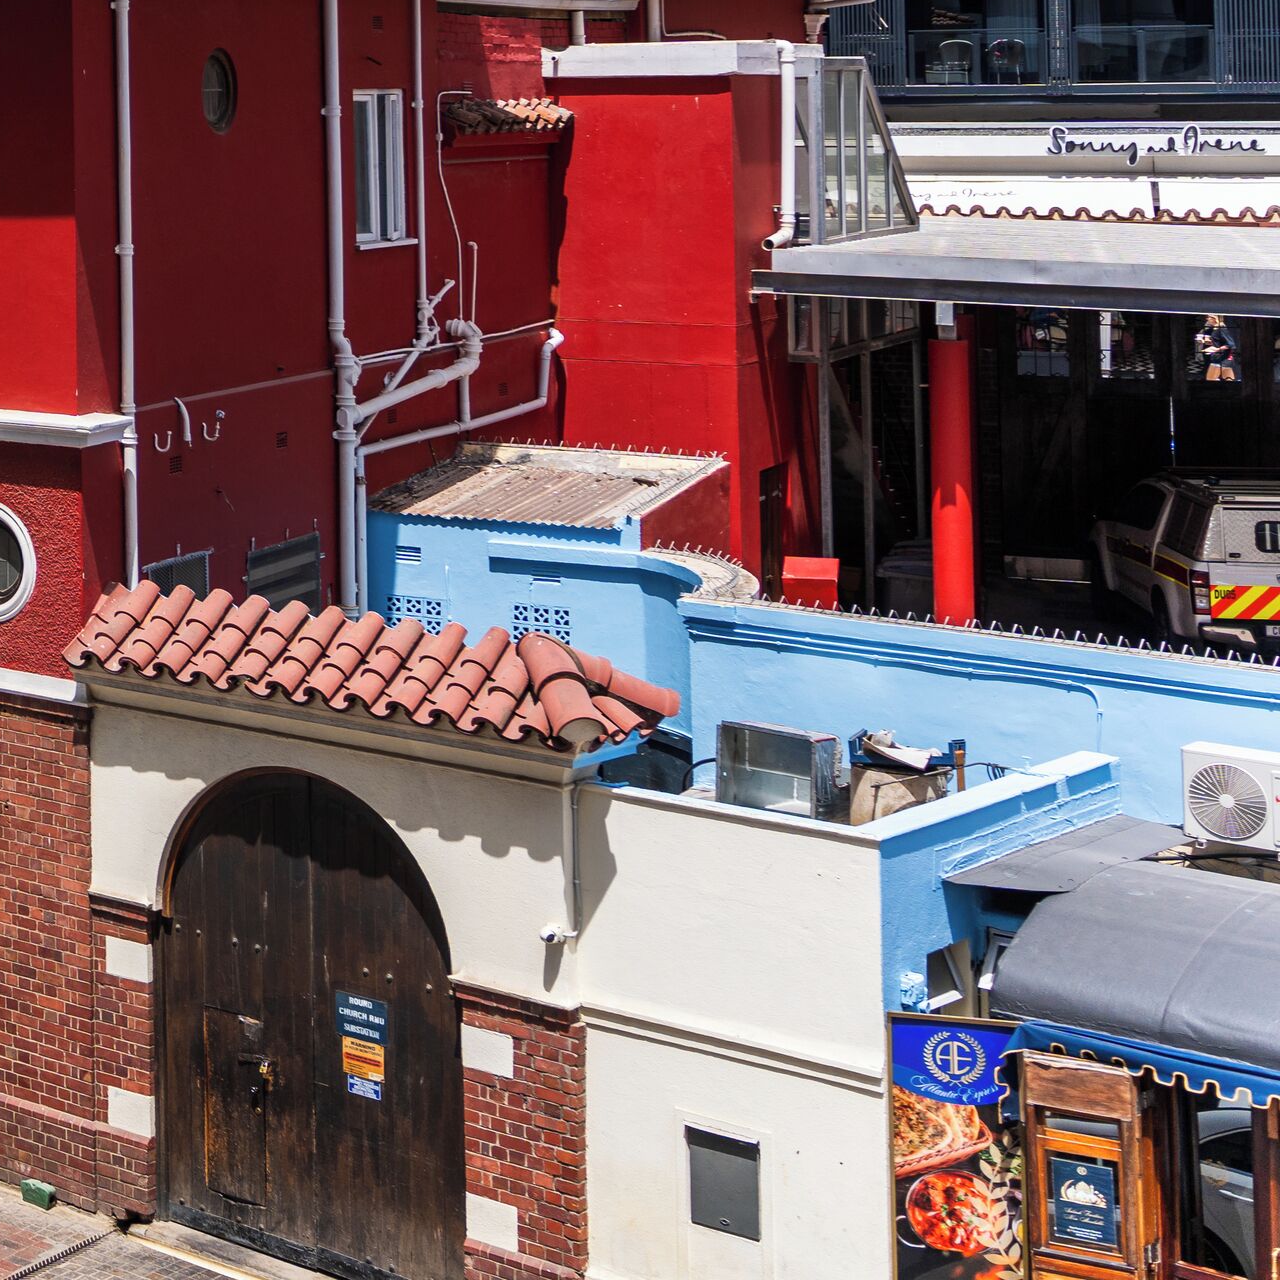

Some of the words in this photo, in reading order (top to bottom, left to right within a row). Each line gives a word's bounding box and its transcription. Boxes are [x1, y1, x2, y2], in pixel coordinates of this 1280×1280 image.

[1047, 127, 1139, 165] Sonny
[1146, 136, 1178, 153] and
[1184, 125, 1266, 154] Irene
[338, 1006, 368, 1021] CHURCH
[910, 1075, 959, 1099] Atlantic
